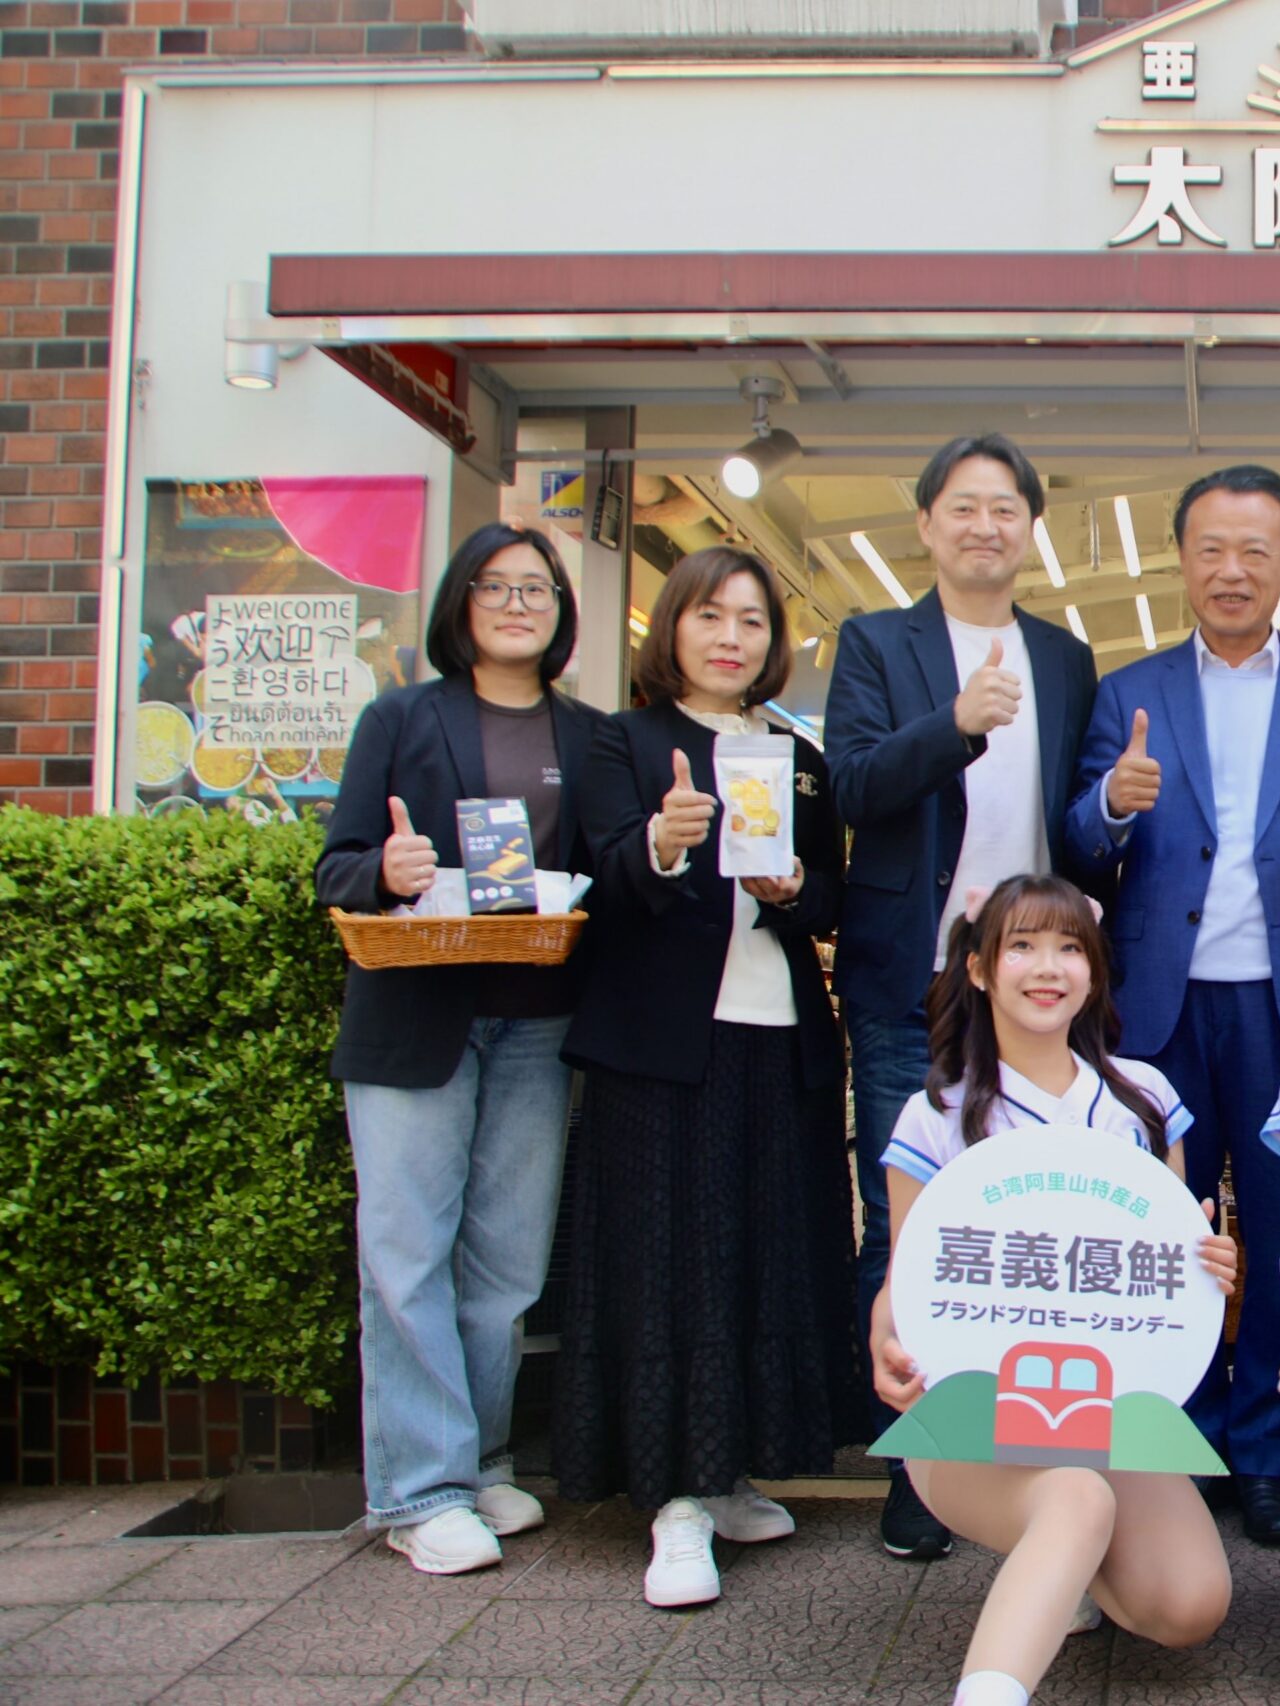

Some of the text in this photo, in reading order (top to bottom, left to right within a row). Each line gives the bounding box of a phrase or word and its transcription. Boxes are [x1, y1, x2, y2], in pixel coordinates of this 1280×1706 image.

[1141, 40, 1198, 102] 亜
[542, 507, 584, 518] ALSO
[233, 623, 313, 663] 欢迎
[210, 602, 232, 743] ようこそ
[231, 666, 349, 697] 환영하다
[981, 1172, 1152, 1220] 台湾阿里山特産品
[934, 1225, 1186, 1301] 嘉義優鮮
[929, 1300, 1185, 1336] ブランドプロモーションデー
